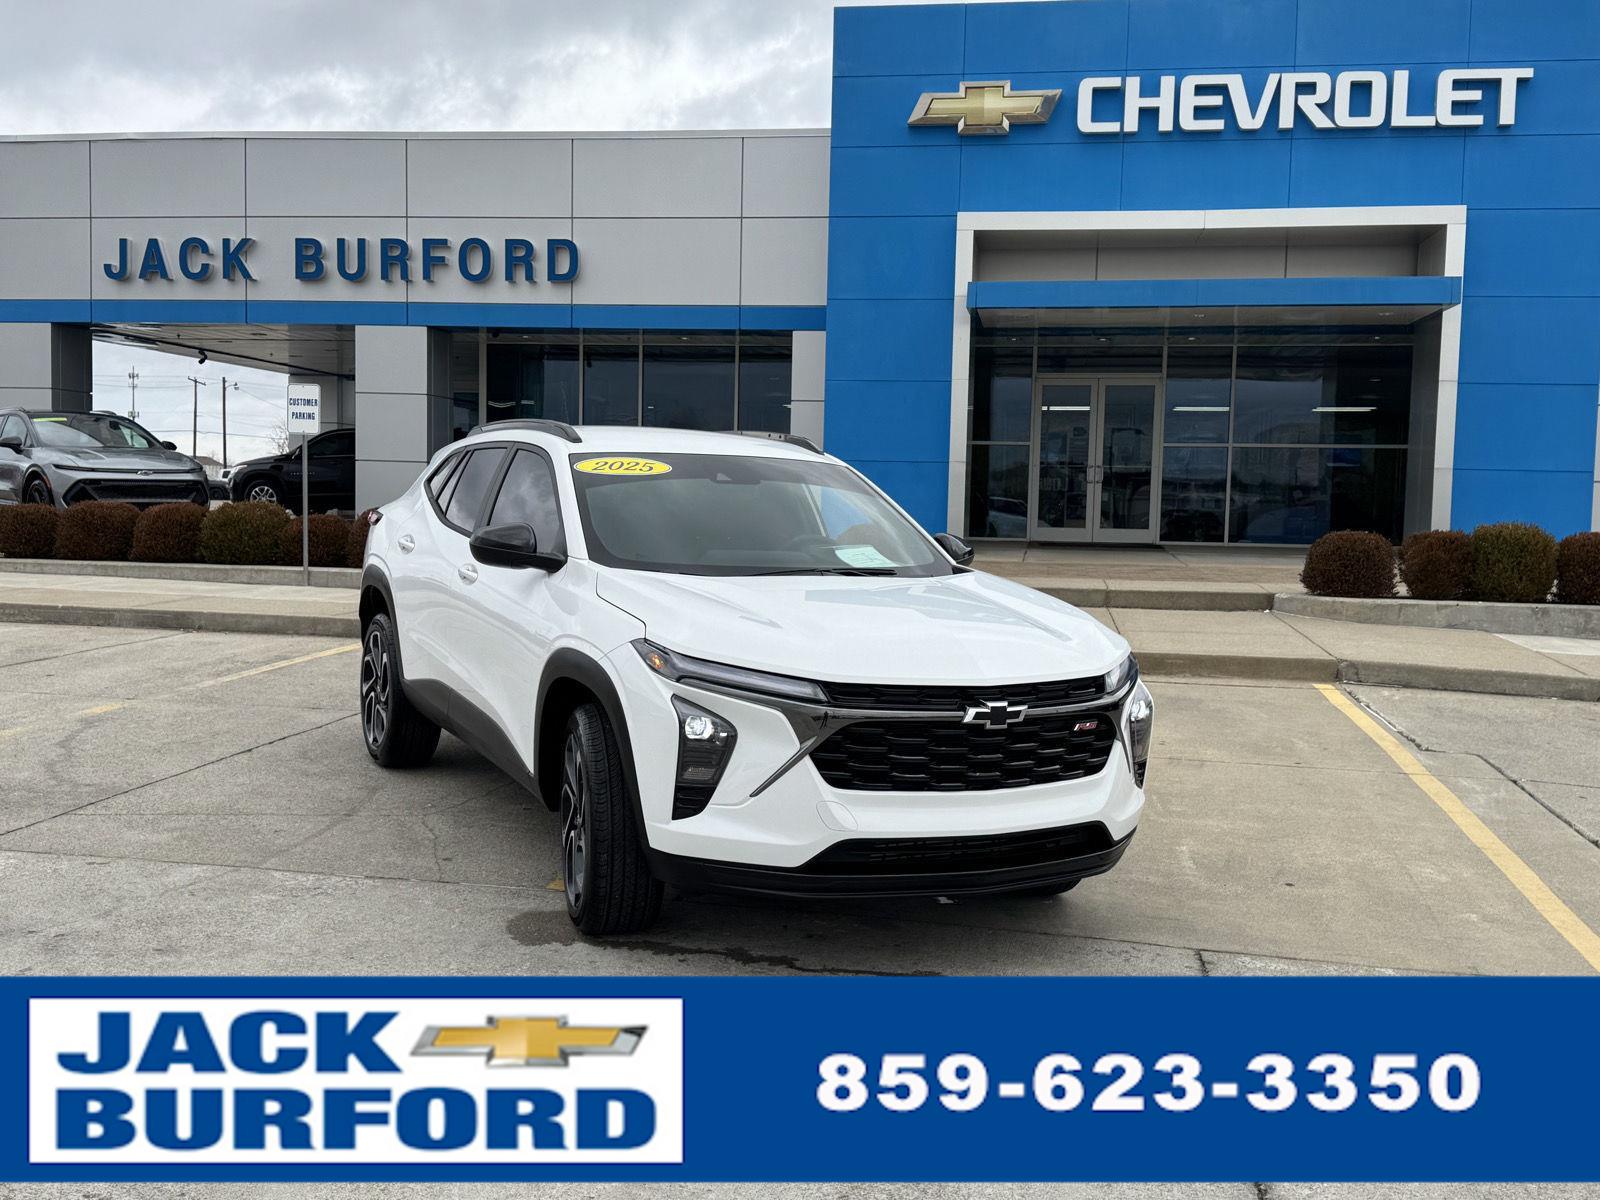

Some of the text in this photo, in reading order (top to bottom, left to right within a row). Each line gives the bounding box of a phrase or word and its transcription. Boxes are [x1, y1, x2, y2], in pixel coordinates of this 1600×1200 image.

[1077, 67, 1534, 135] CHEVROLET
[103, 236, 580, 284] JACK BURFORD
[289, 398, 318, 406] CUSTOMER
[291, 412, 316, 420] PARKING
[592, 460, 656, 472] 2025
